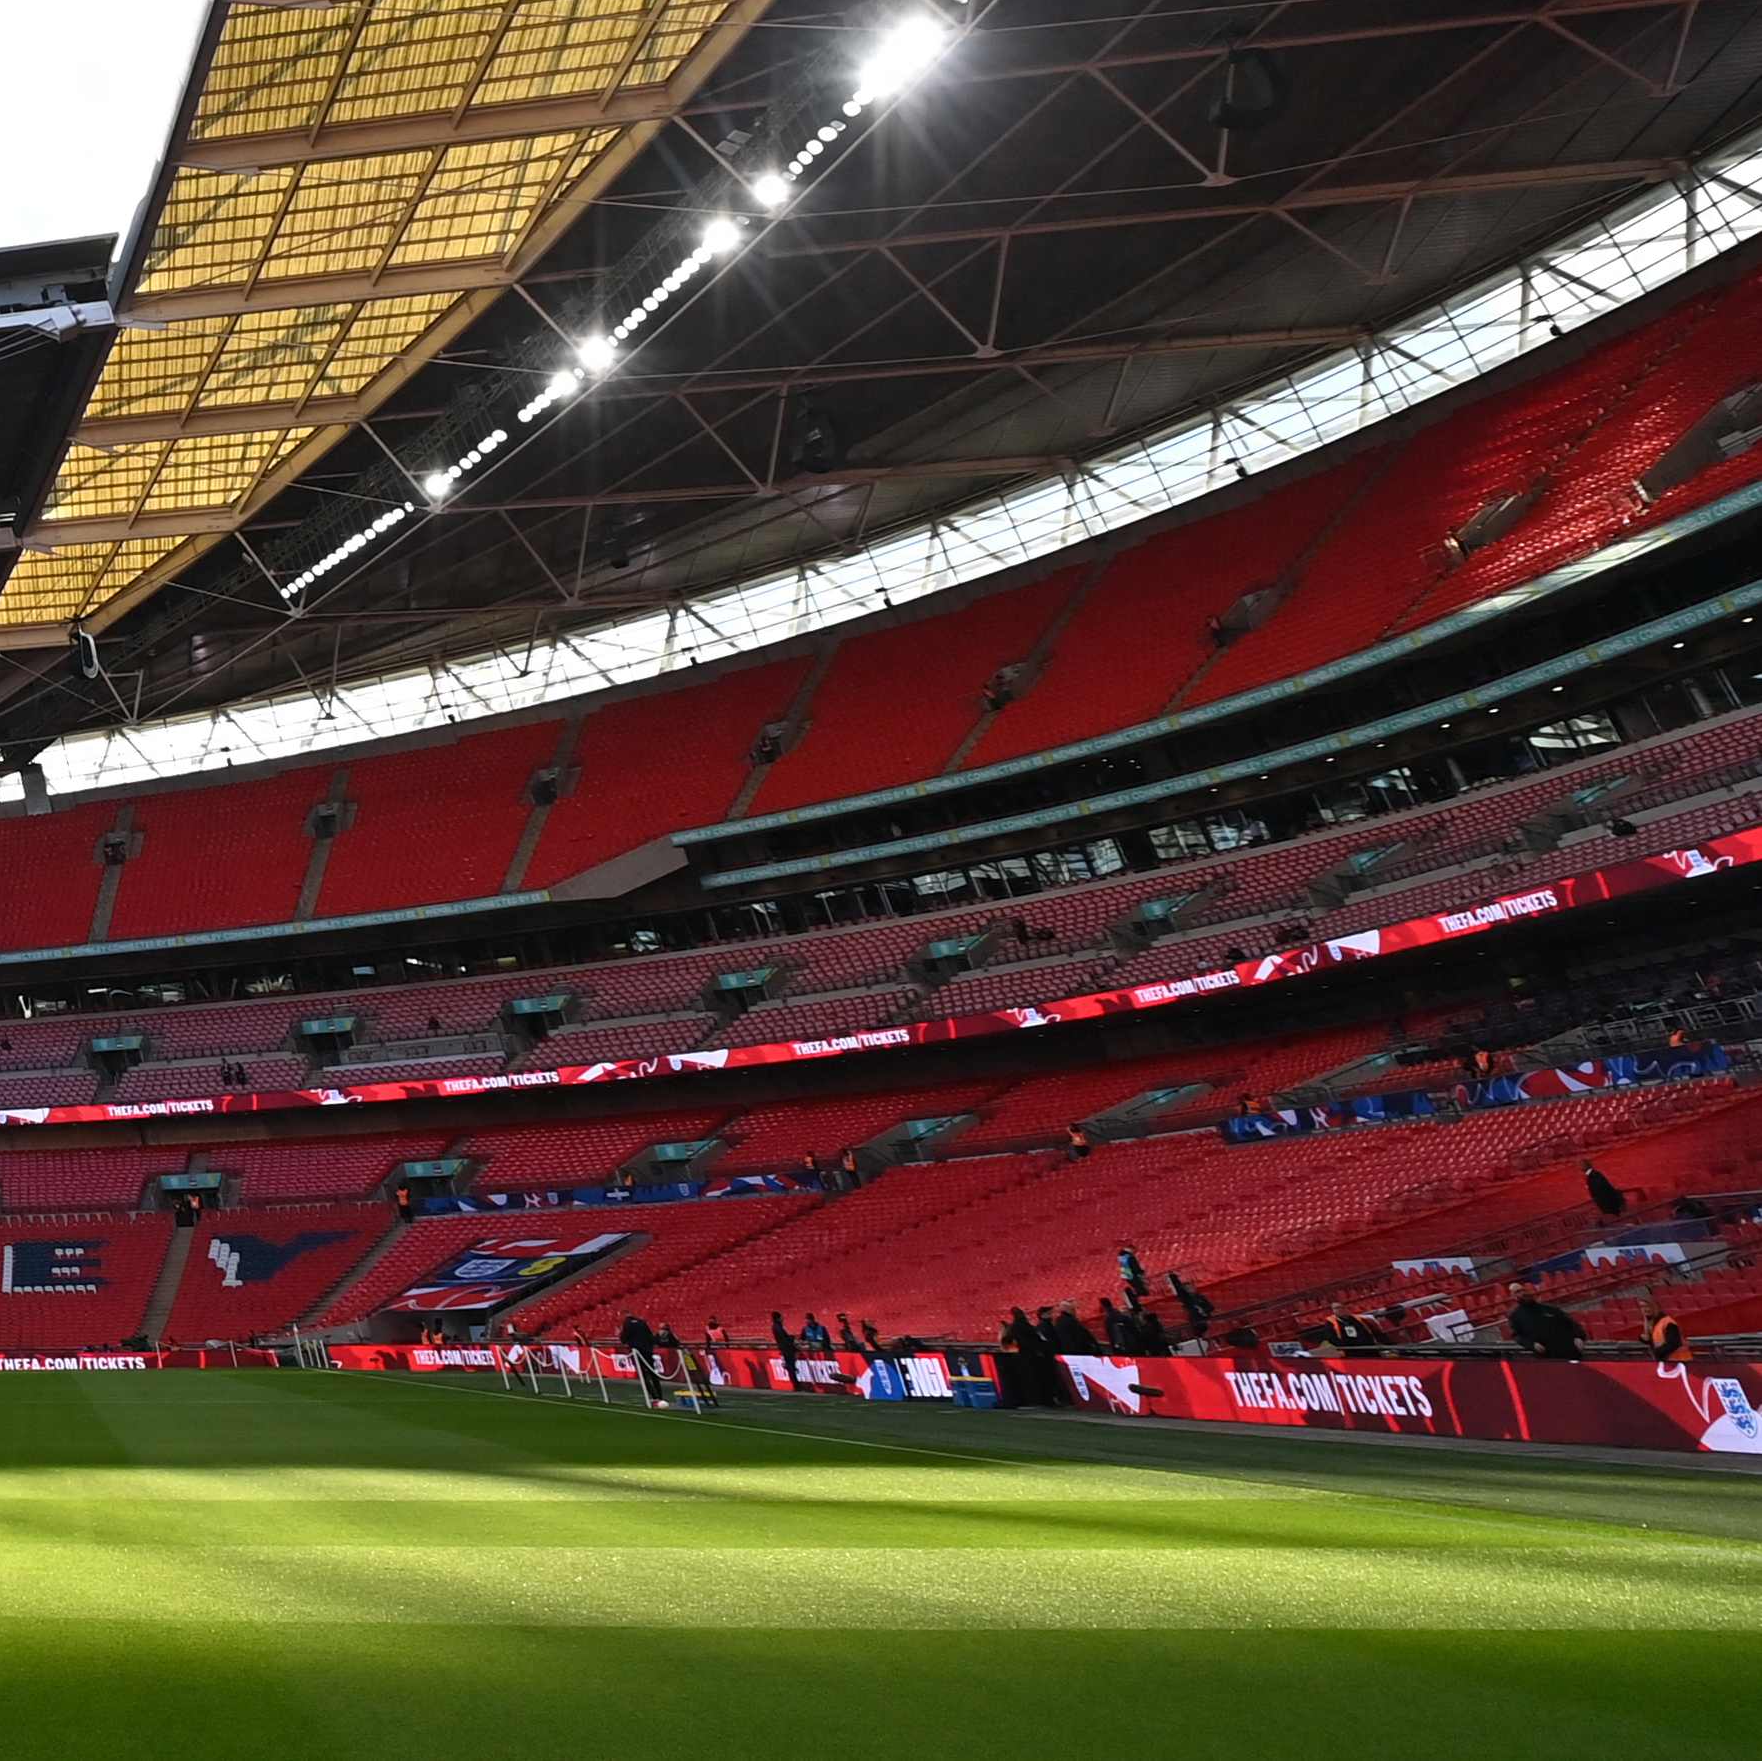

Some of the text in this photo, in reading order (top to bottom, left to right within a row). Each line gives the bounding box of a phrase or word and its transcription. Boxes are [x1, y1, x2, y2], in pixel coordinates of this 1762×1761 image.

[1438, 890, 1557, 934] THEFA.COM/TICKETS
[1135, 969, 1241, 1007] THEFA.COM/TICKETS
[793, 1028, 910, 1055] THEFA.COM/TICKETS
[444, 1071, 560, 1093] THEFA.COM/TICKETS
[107, 1099, 214, 1118] THEFA.COM/TICKETS
[413, 1350, 495, 1366] THEFA.COM/TICKETS
[1223, 1370, 1434, 1420] THEFA.COM/TICKETS
